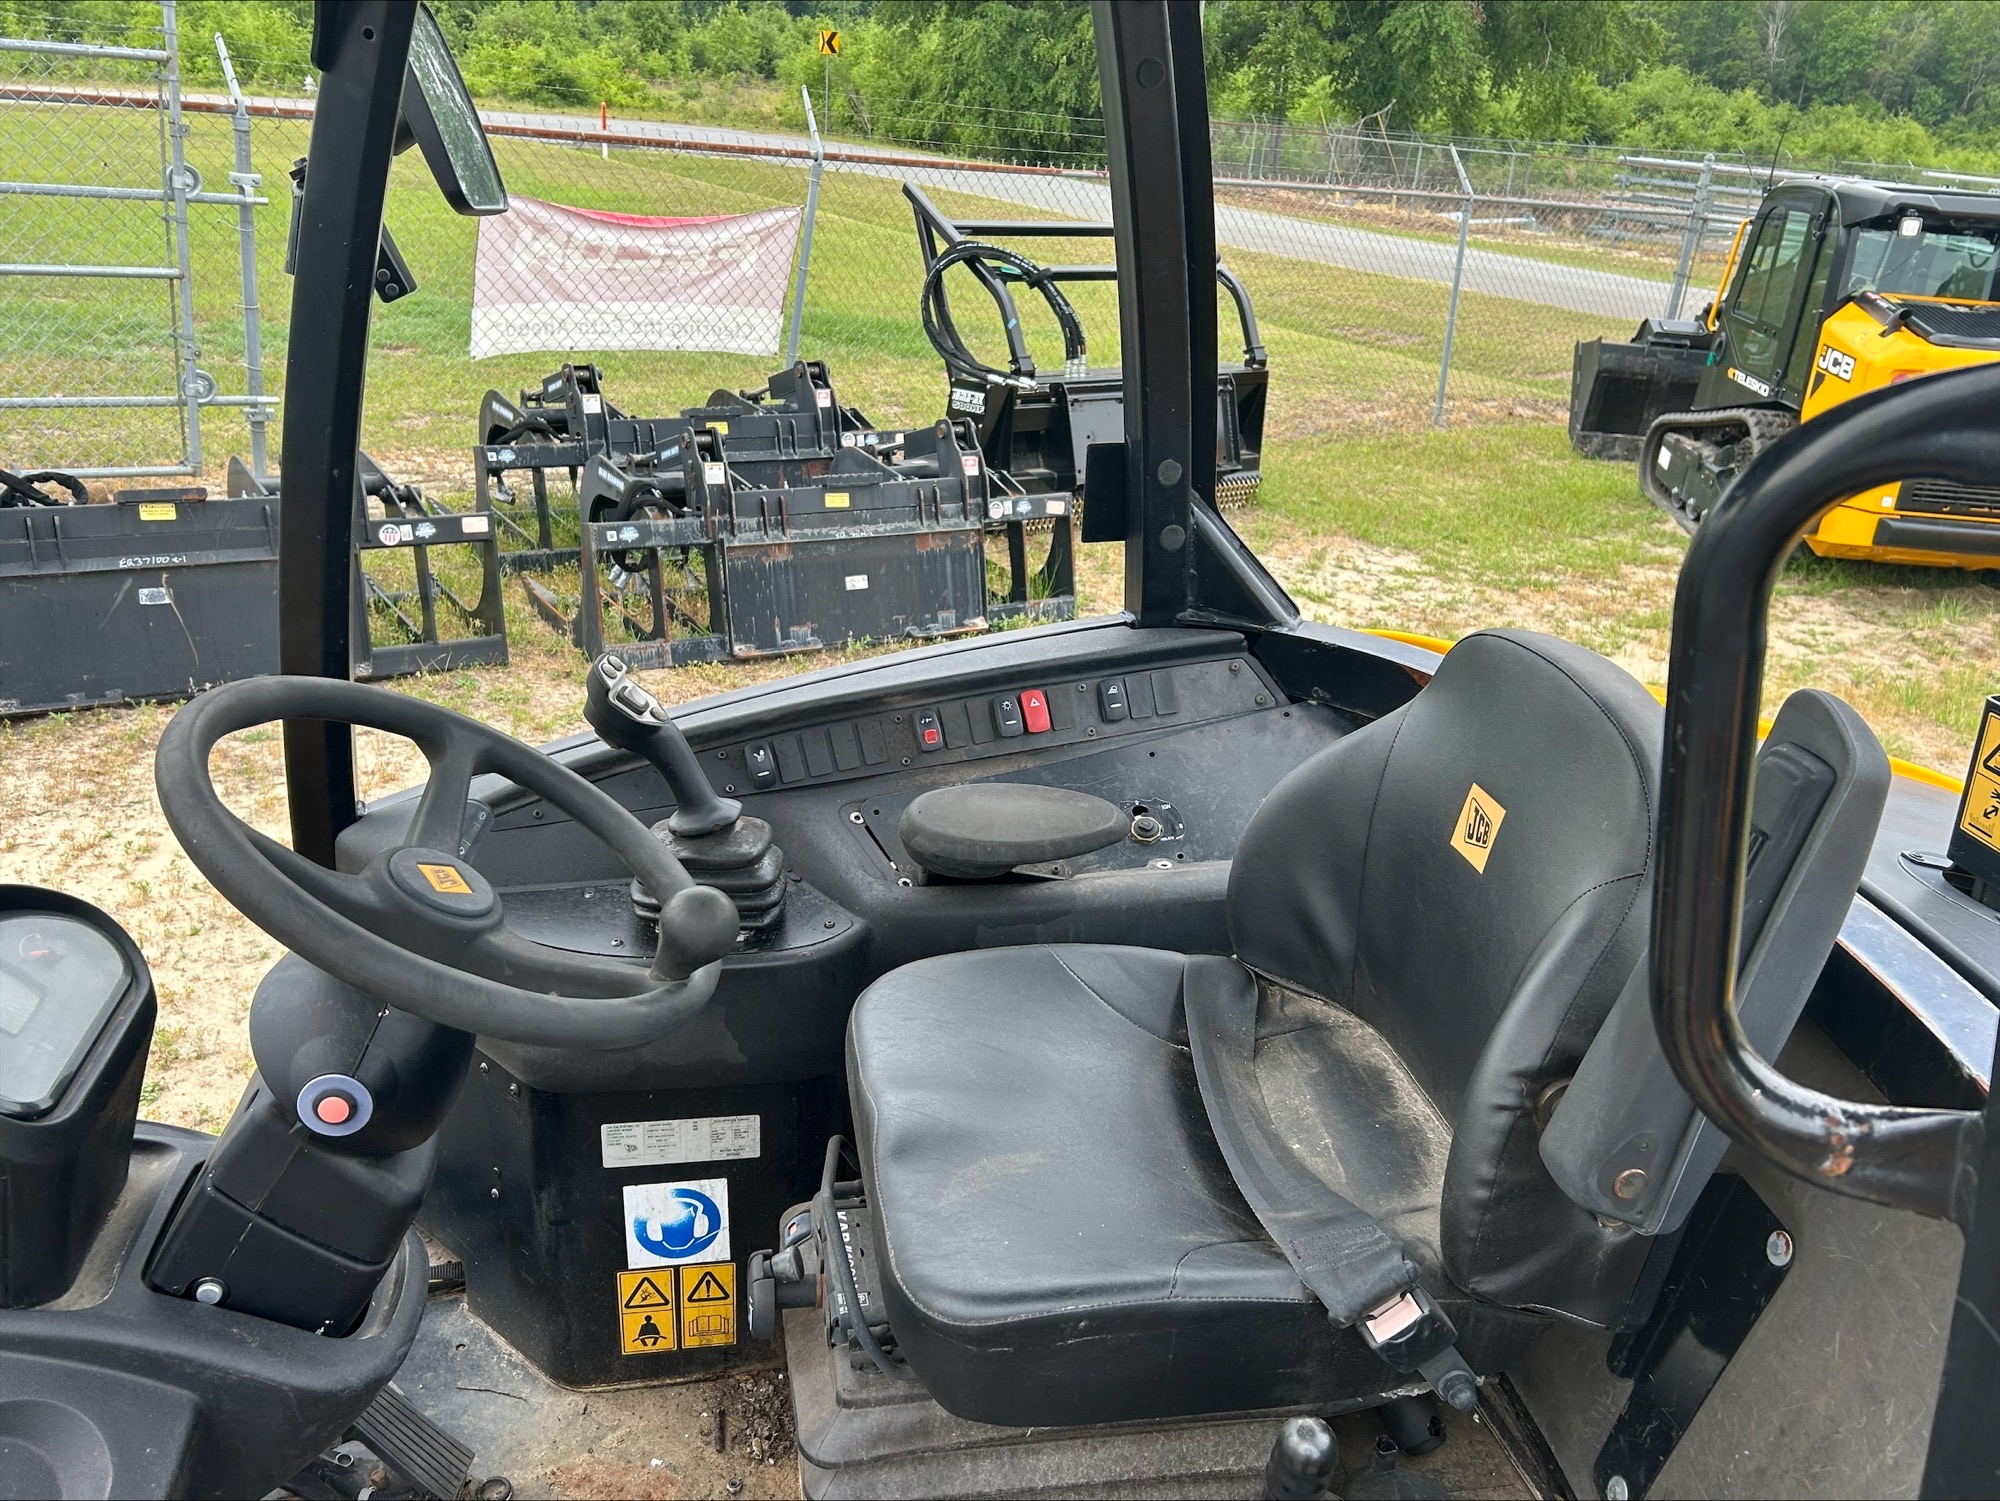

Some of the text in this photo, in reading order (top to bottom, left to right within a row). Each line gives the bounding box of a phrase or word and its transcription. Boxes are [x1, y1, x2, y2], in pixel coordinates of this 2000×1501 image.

[1818, 346, 1856, 381] JCB
[1733, 370, 1770, 397] TELESKID
[1466, 804, 1491, 845] JCB
